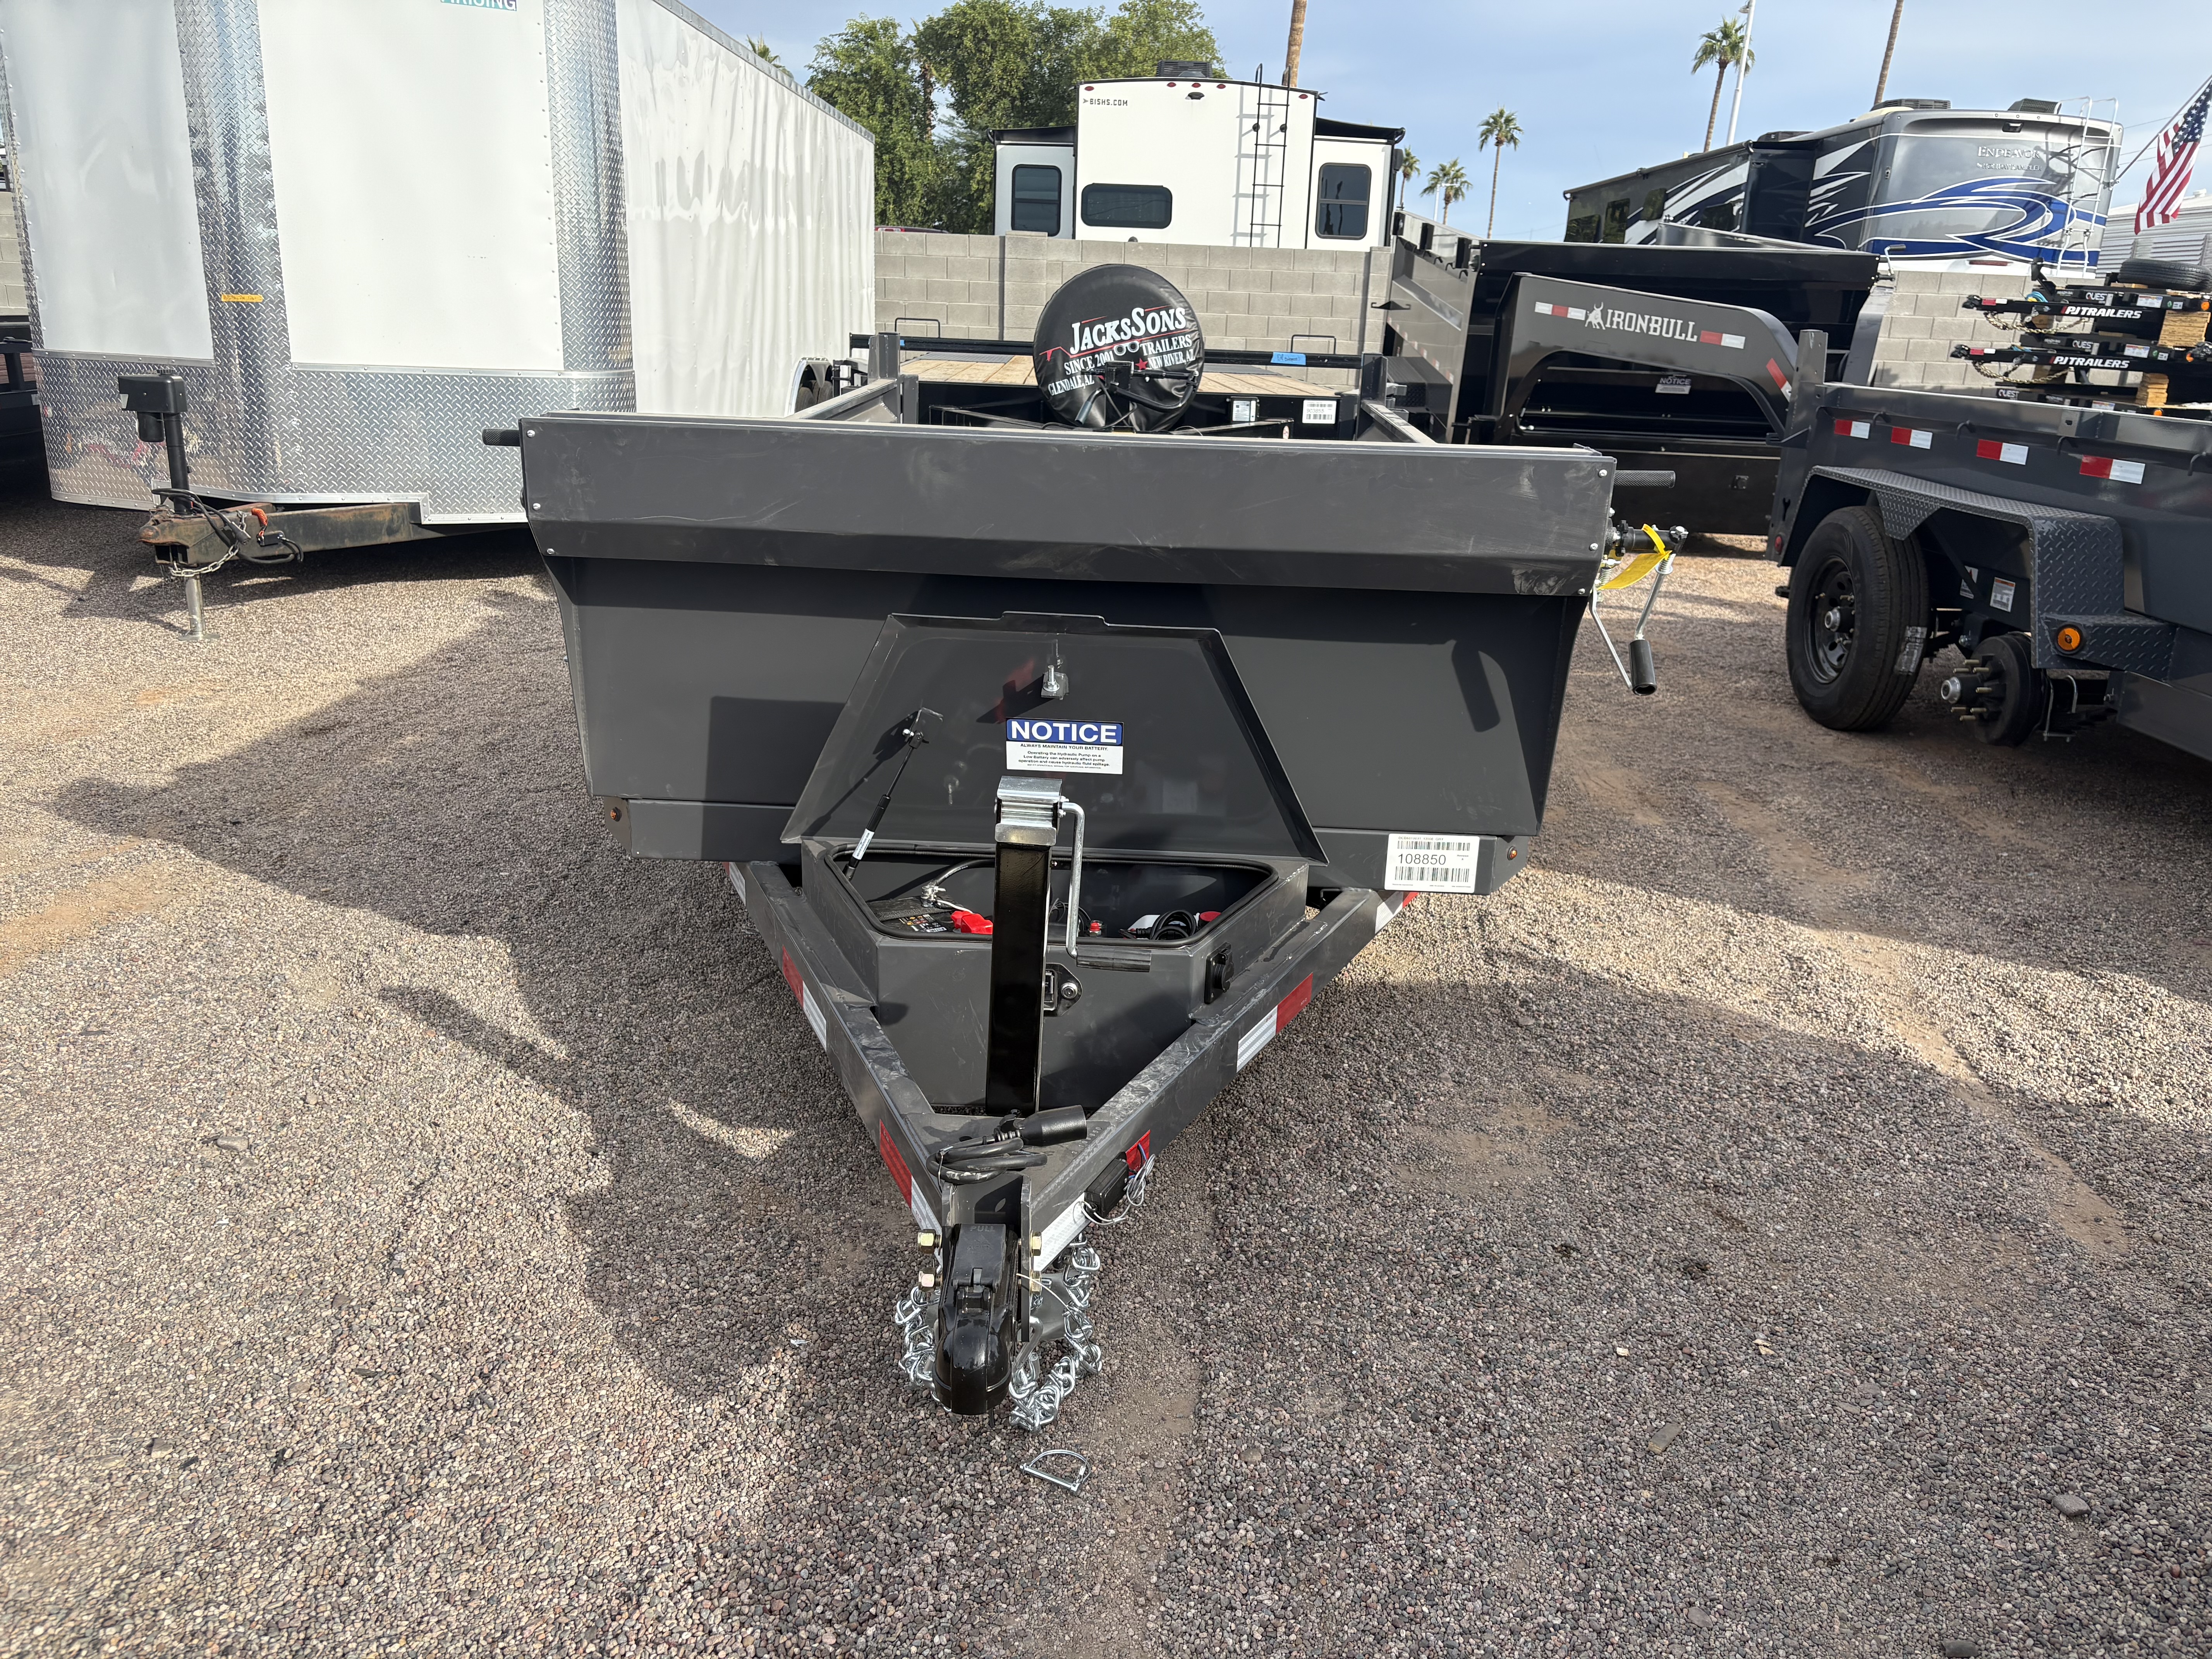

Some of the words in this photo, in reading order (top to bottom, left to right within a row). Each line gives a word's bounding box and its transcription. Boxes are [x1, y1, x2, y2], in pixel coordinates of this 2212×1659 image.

[1978, 146, 2040, 158] ENDEAVOR
[1606, 309, 1698, 342] IRONBULL
[1140, 334, 1192, 356] TRAILERS
[1064, 356, 1095, 375] SINCE
[1147, 356, 1163, 369] NEW
[1186, 349, 1195, 362] AZ
[1012, 721, 1117, 743] NOTICE
[1398, 854, 1446, 865] 108850
